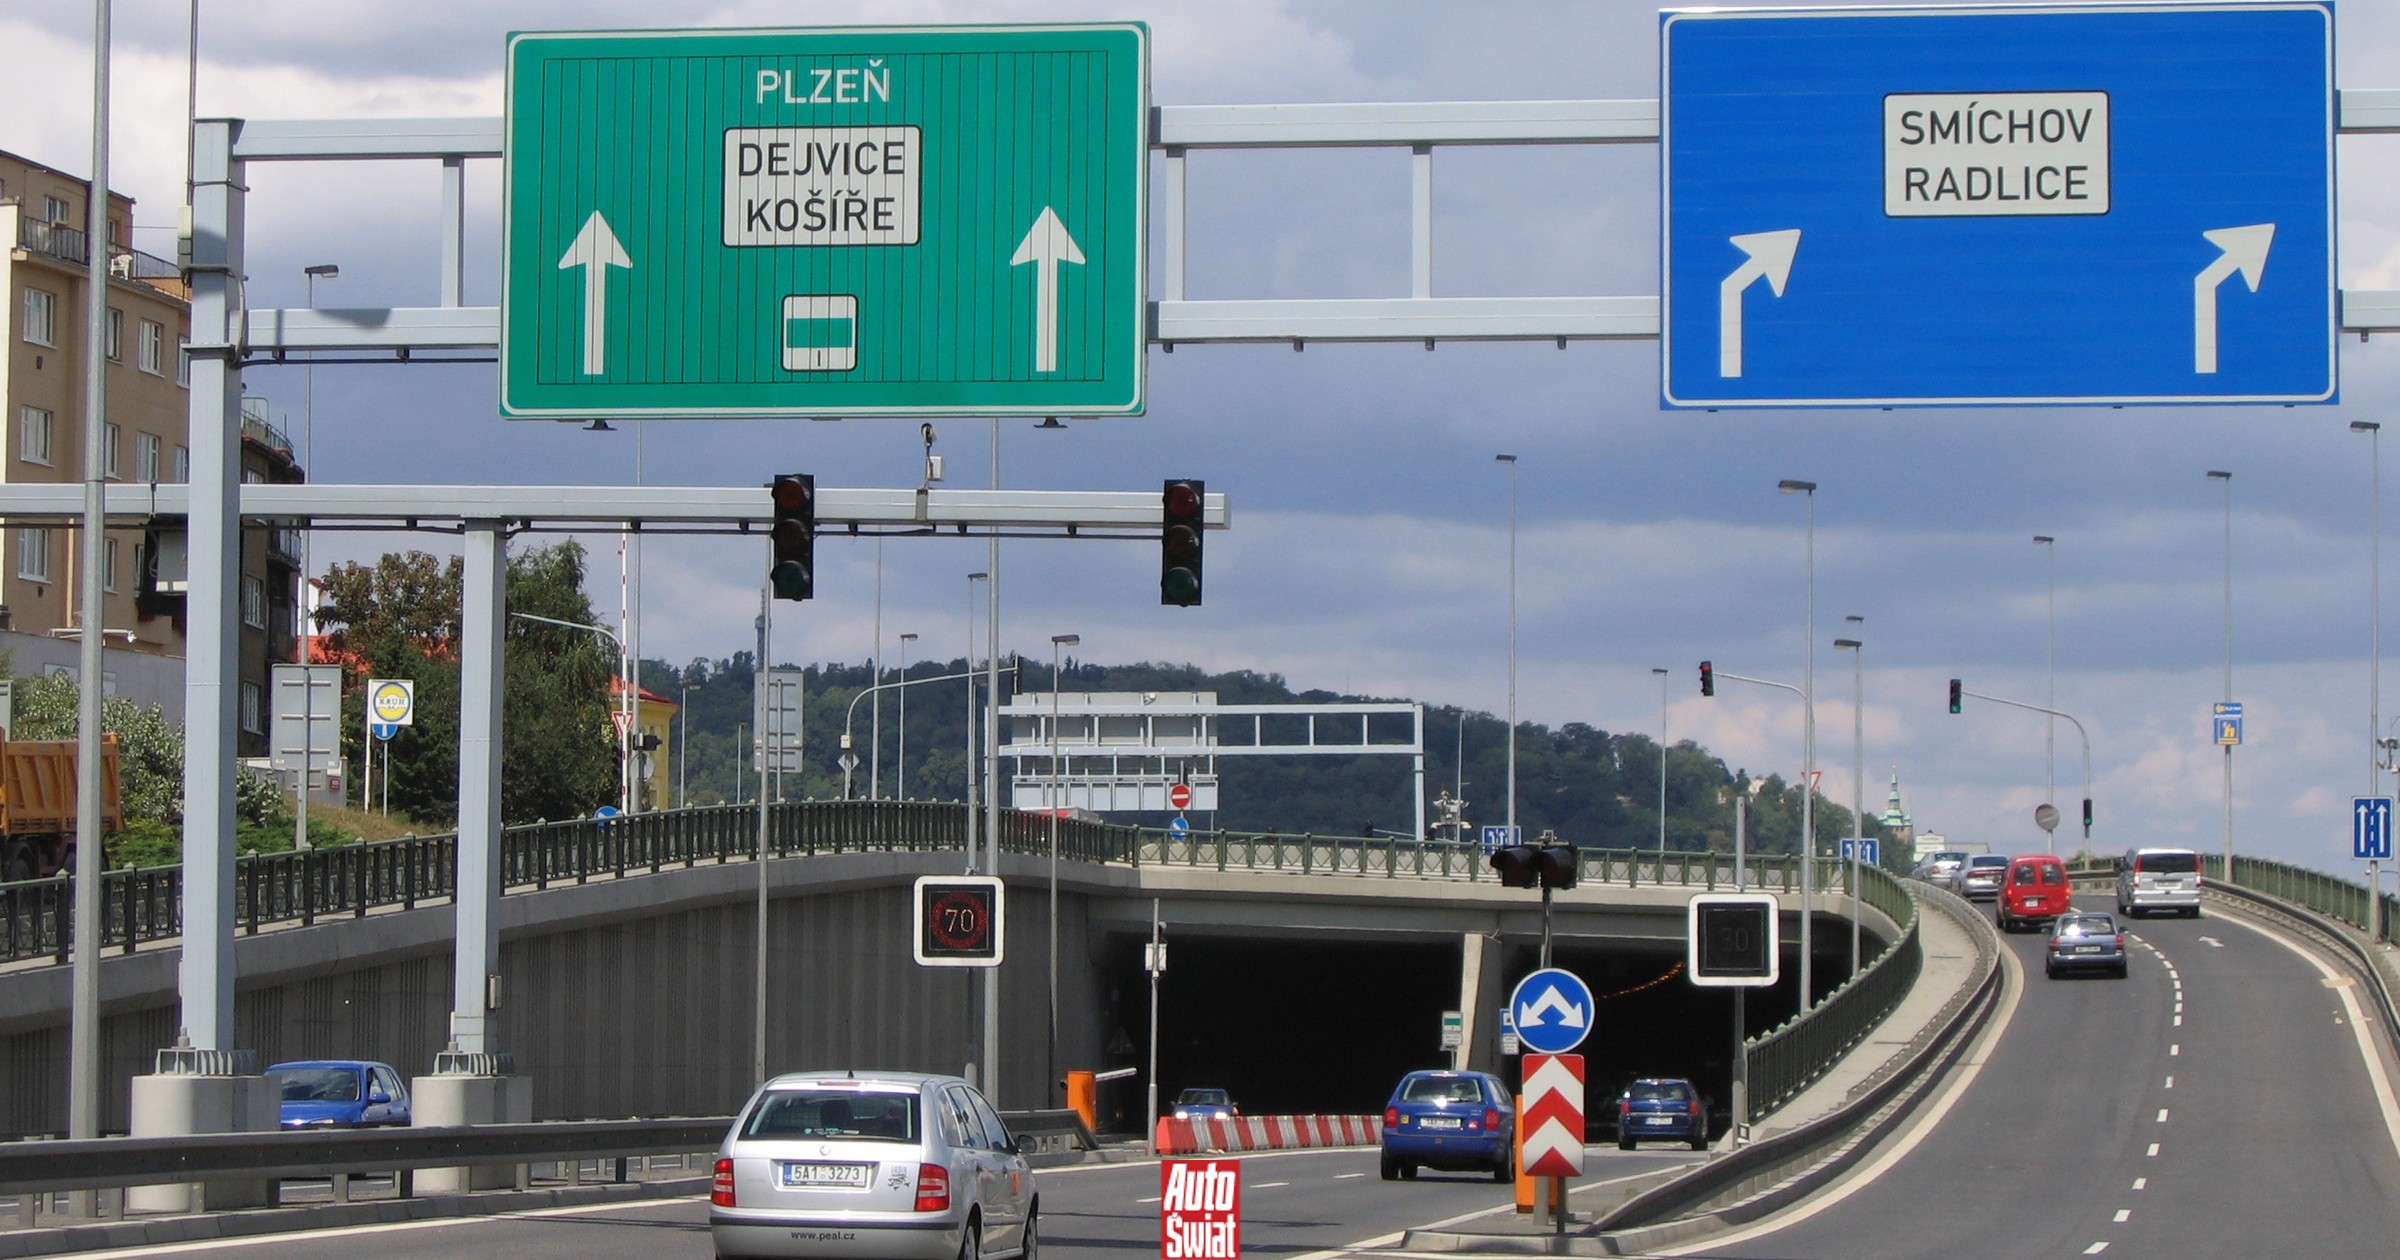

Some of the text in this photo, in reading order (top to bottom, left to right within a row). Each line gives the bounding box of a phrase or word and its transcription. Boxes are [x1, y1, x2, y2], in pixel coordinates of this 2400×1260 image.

[757, 59, 890, 104] PLZEŇ
[1900, 101, 2093, 145] SMÍCHOV
[739, 141, 905, 176] DEJVICE
[1905, 166, 2089, 201] RADLICE
[747, 189, 895, 232] KOŠÍŘE
[945, 908, 974, 932] 70
[794, 1166, 818, 1179] 5A1
[828, 1167, 860, 1180] 3273
[790, 1231, 856, 1241] www.peal.cz
